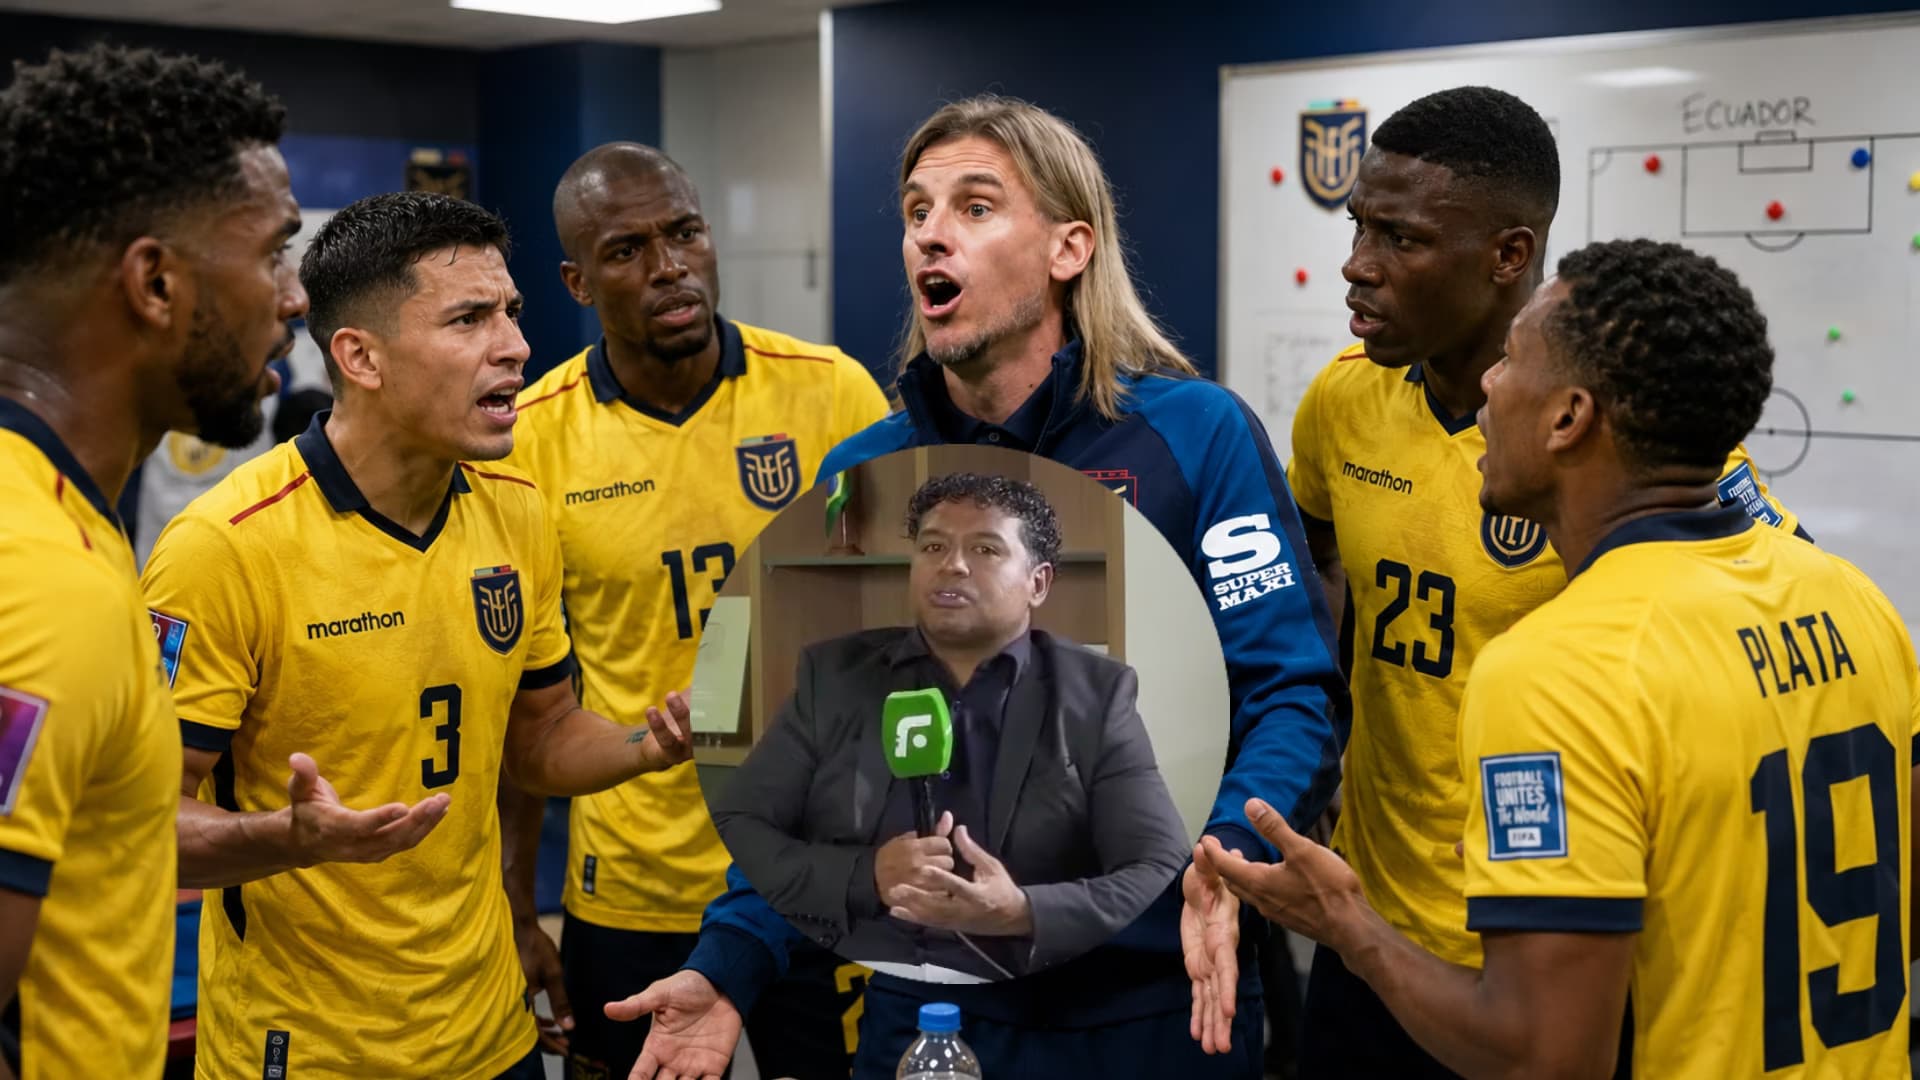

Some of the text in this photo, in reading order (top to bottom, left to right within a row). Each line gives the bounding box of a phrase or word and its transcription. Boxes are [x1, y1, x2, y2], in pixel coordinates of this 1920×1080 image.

[1682, 92, 1816, 134] ECUADOR
[565, 479, 655, 505] marathon
[1342, 461, 1413, 494] marathon
[1213, 562, 1292, 596] SUPER
[1217, 573, 1296, 611] MAXI
[307, 610, 405, 640] marathon
[1372, 558, 1456, 679] 23
[1738, 611, 1857, 698] PLATA
[419, 683, 462, 790] 3
[1496, 785, 1546, 806] UNITES
[1750, 722, 1906, 1072] 19
